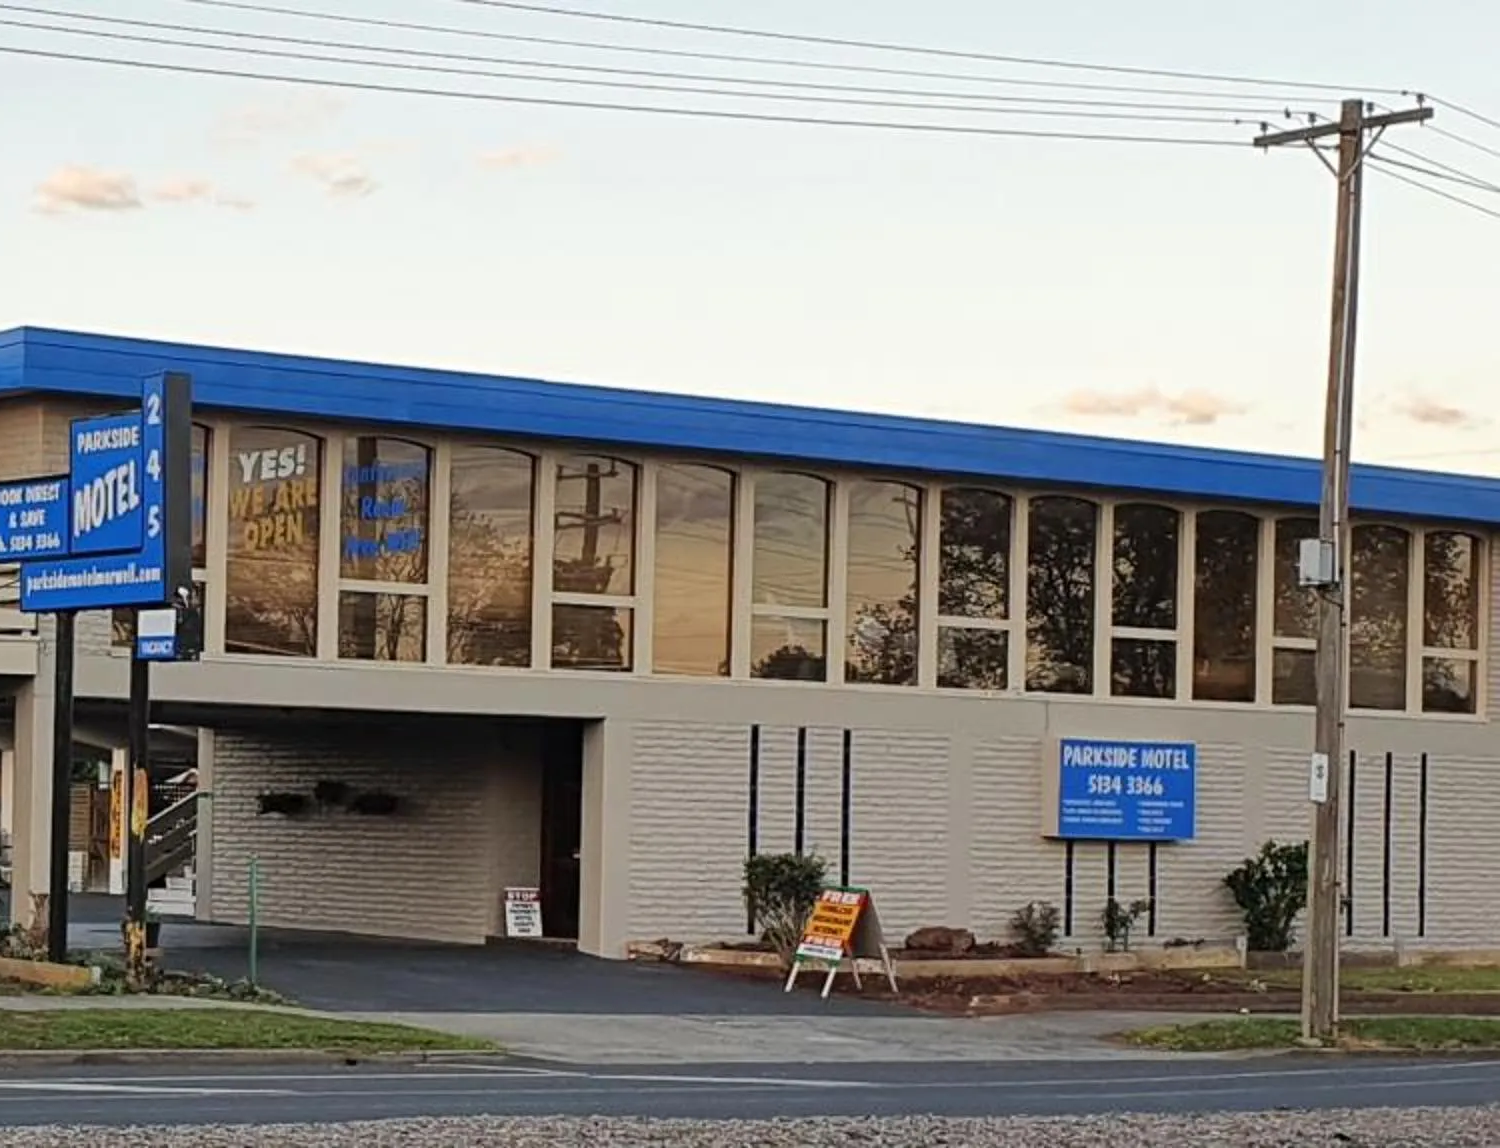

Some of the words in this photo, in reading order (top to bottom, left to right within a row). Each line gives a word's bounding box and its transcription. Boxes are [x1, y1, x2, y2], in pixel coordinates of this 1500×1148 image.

[77, 425, 140, 454] PARKSIDE
[239, 444, 305, 483] YES!
[25, 482, 60, 503] DIRECT
[74, 459, 140, 538] MOTEL
[230, 486, 265, 518] WE
[272, 477, 318, 512] ARE
[8, 511, 18, 529] &
[20, 509, 45, 528] SAVE
[10, 533, 32, 553] 5134
[35, 531, 60, 551] 3366
[244, 513, 303, 551] OPEN
[1063, 745, 1137, 769] PARKSIDE
[1140, 748, 1190, 770] MOTEL
[1087, 774, 1120, 795] 5134
[1126, 774, 1163, 796] 3366
[508, 891, 538, 901] STOP
[821, 890, 861, 905] FREE
